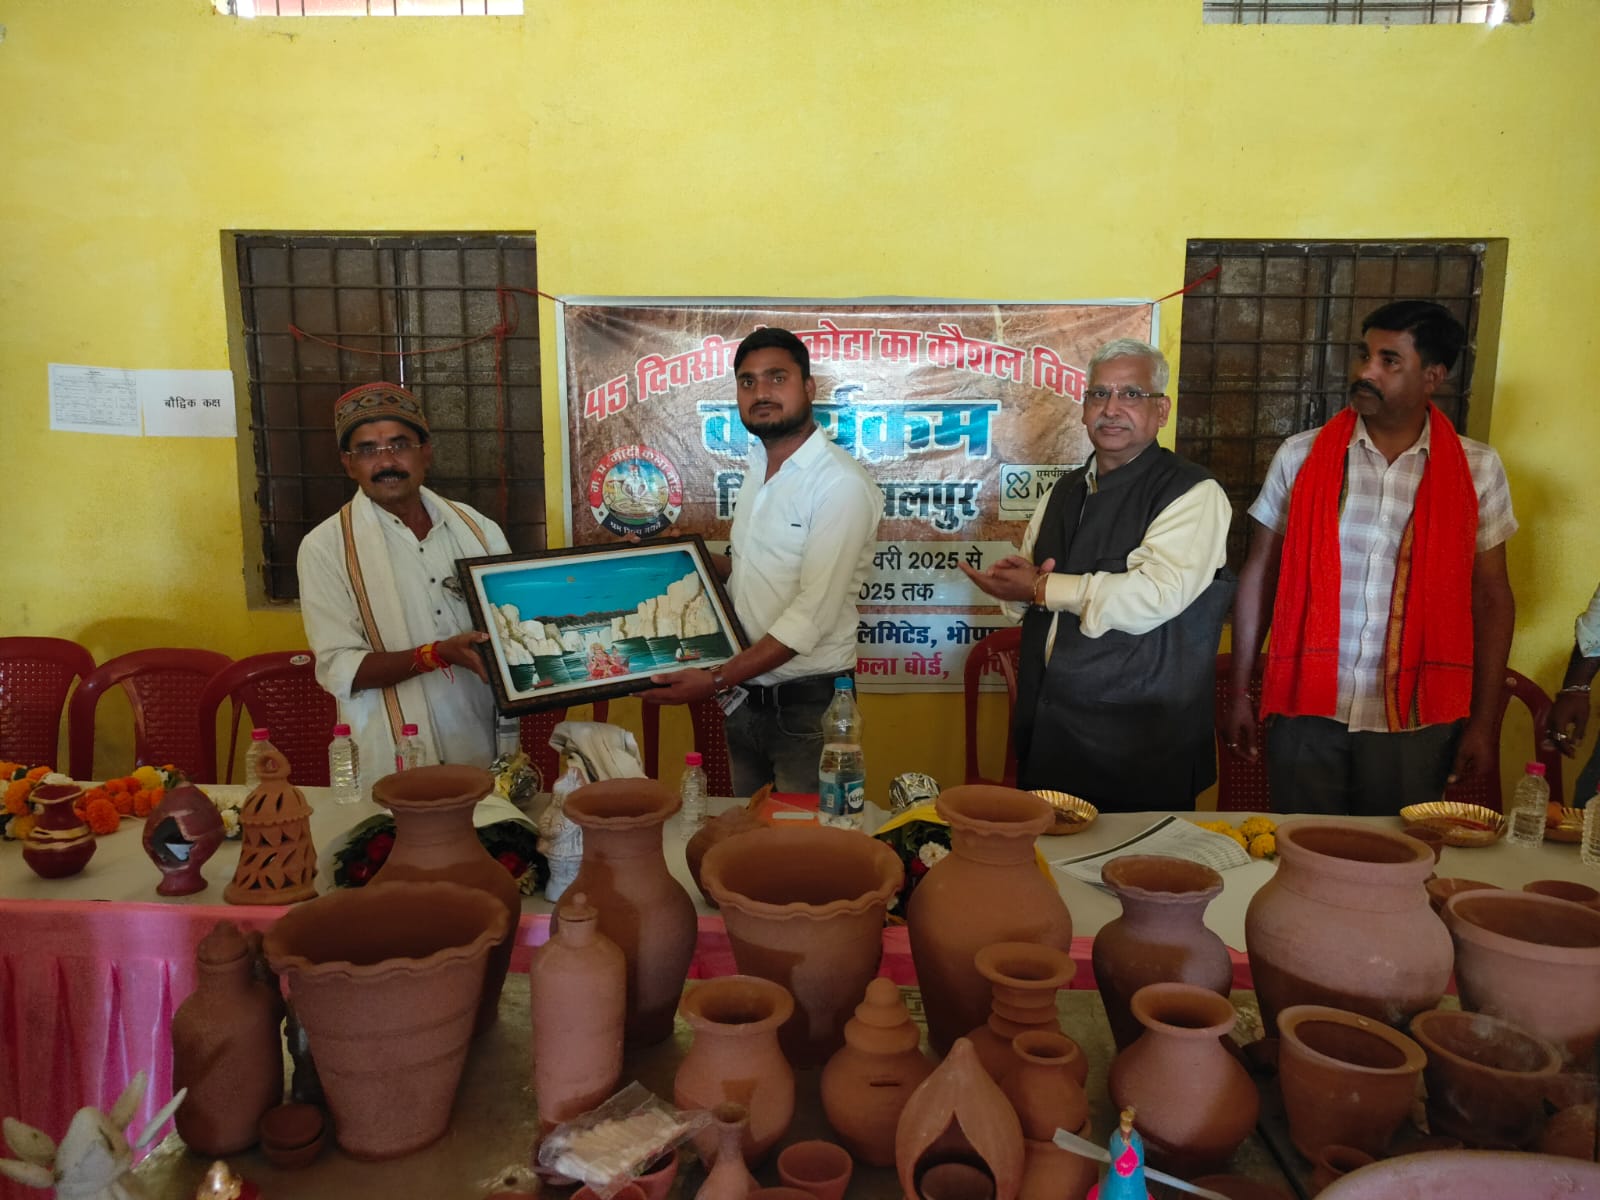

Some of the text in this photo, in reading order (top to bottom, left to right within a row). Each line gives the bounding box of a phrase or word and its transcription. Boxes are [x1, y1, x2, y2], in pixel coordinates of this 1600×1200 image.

[584, 375, 627, 421] 45
[755, 320, 875, 363] कोटा
[878, 329, 921, 363] का
[926, 323, 1025, 383] कौशल
[1032, 346, 1087, 404] विक
[908, 551, 959, 569] 2025
[964, 545, 984, 570] से
[859, 582, 934, 601] 025 तक
[904, 652, 950, 680] बोर्ड,
